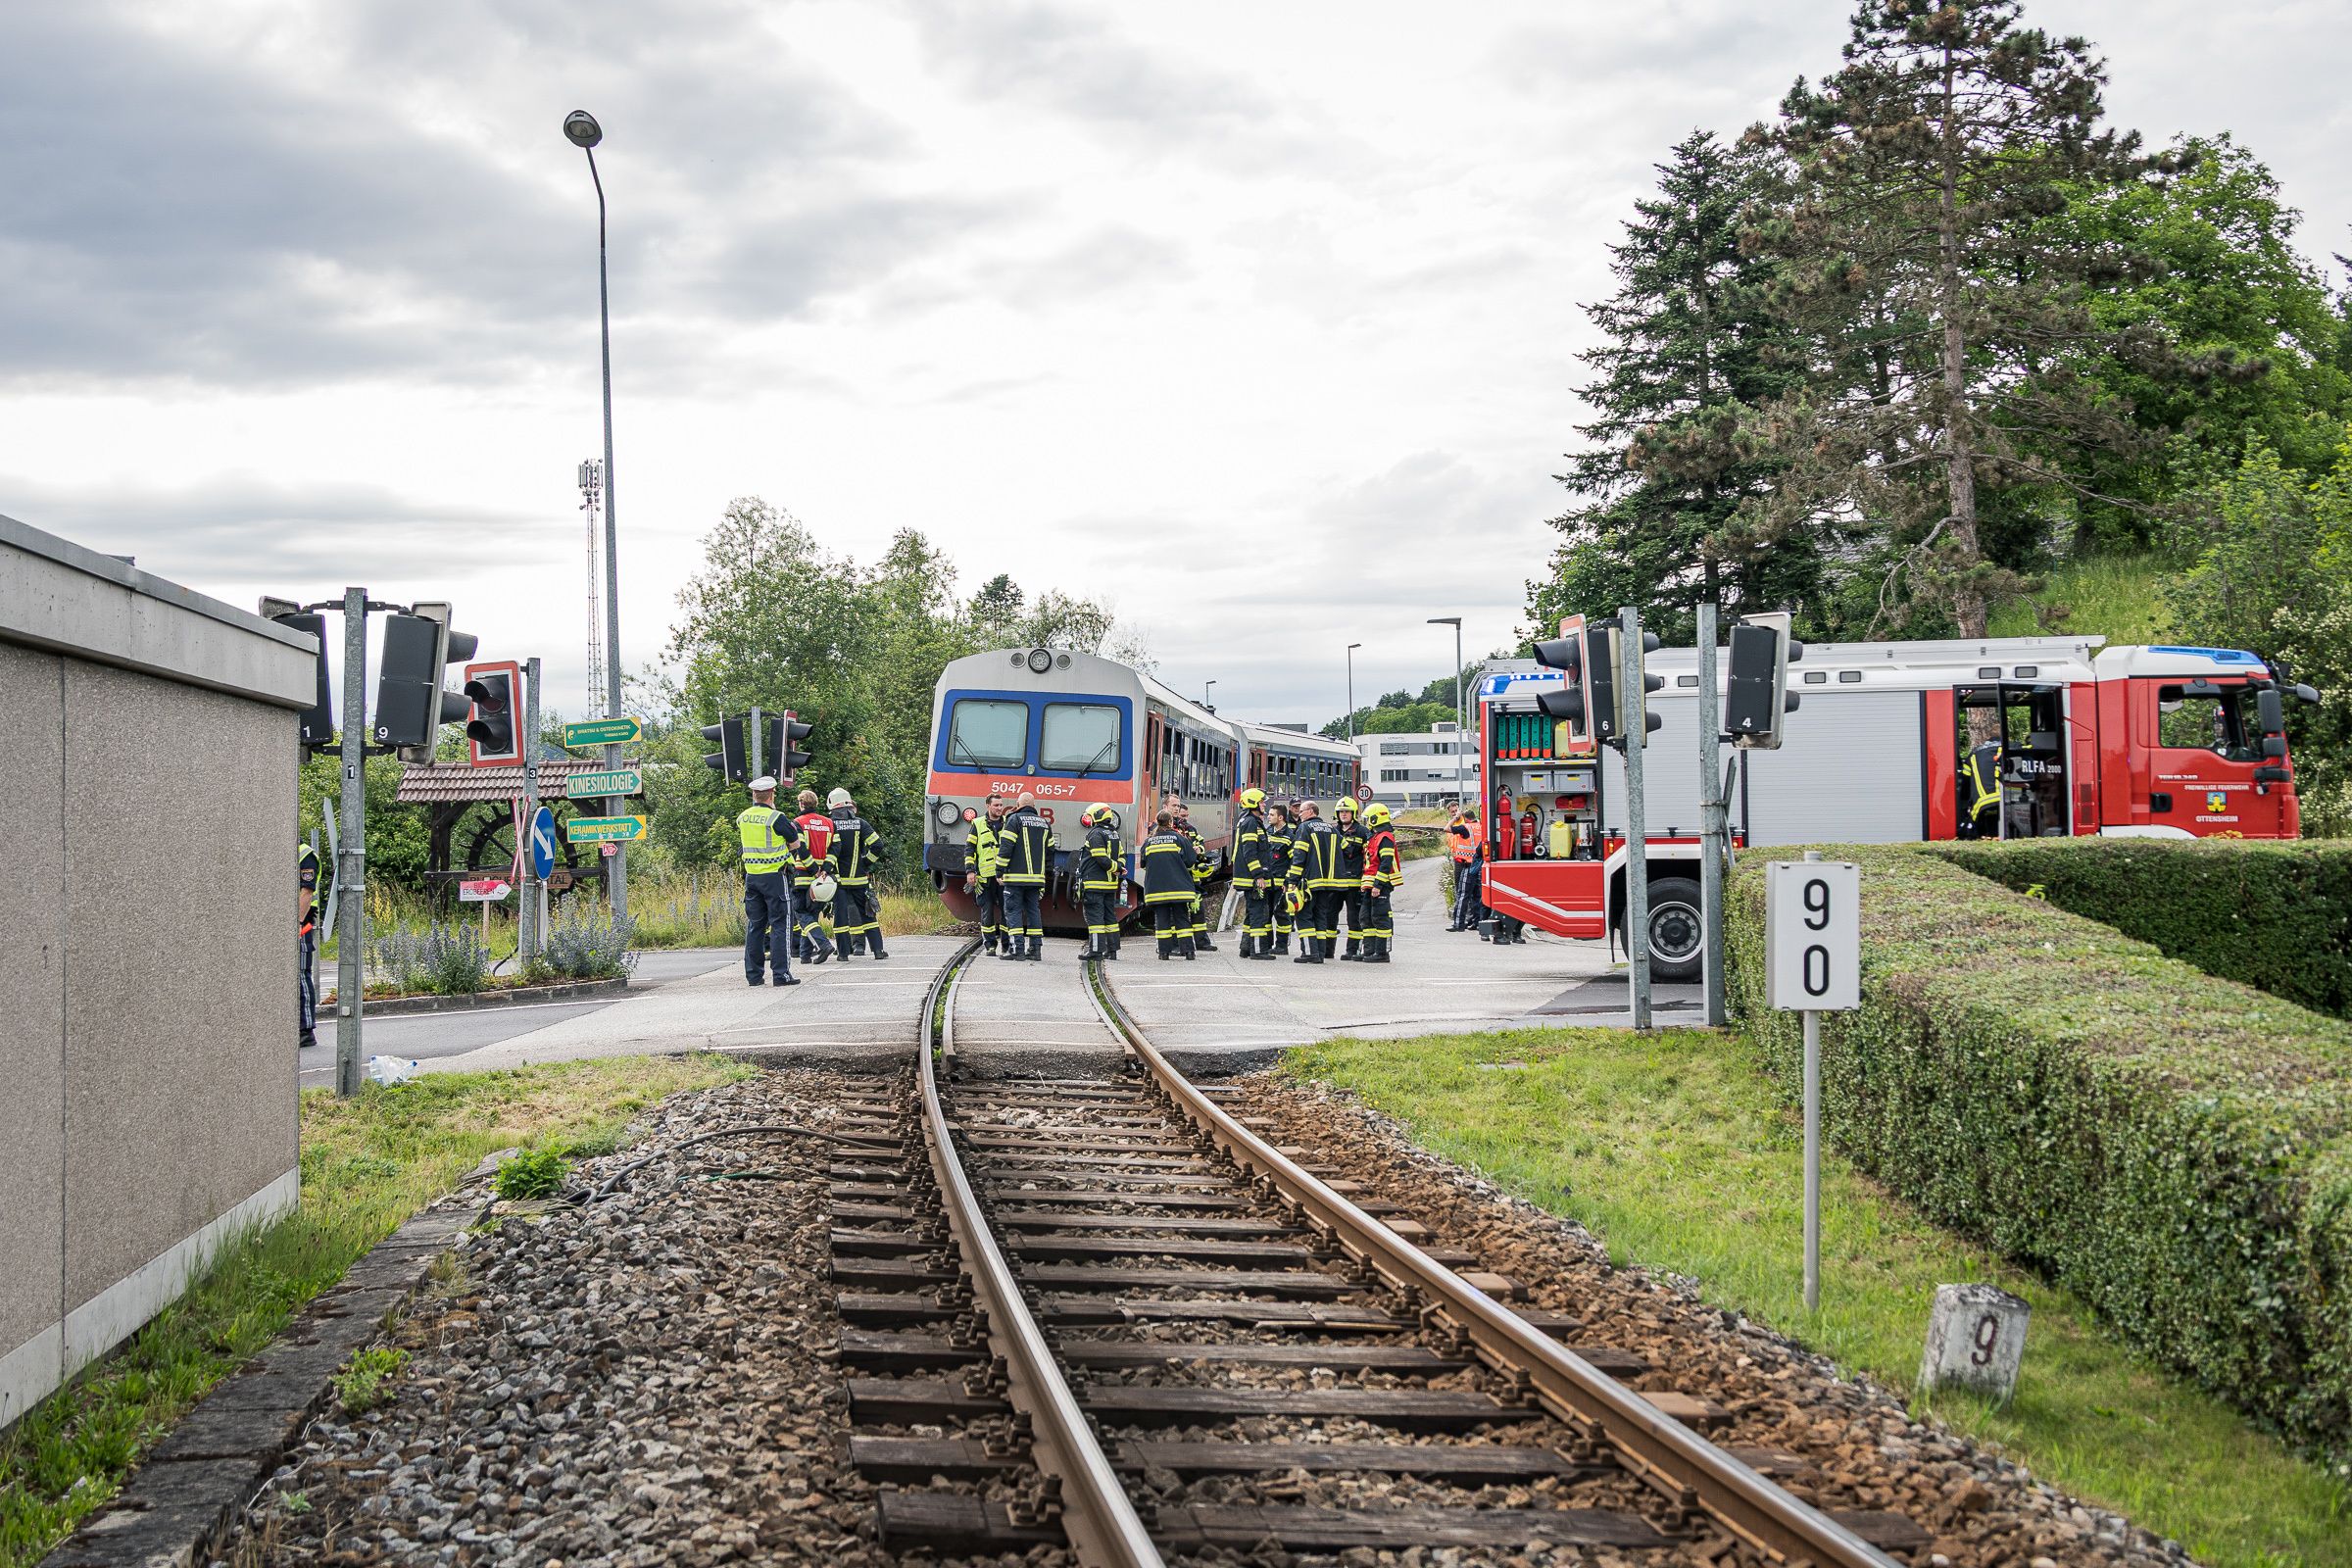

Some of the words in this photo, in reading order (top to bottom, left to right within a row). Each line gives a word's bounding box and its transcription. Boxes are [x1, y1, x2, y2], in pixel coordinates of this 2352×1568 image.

[1601, 720, 1609, 731] 6
[1741, 716, 1752, 728] 4
[303, 725, 311, 738] 1
[378, 726, 389, 739] 9
[347, 764, 355, 779] 1
[2021, 760, 2046, 773] RLFA
[529, 769, 537, 779] 3
[568, 773, 634, 795] KINESIOLOGIE
[991, 781, 1024, 794] 5047
[1036, 783, 1077, 797] 065-7
[1359, 788, 1369, 798] 30
[741, 813, 768, 825] OLIZEI
[569, 822, 632, 835] KERAMIKWERKSTATT
[1803, 878, 1830, 931] 9
[1803, 944, 1830, 997] 0
[1971, 1314, 1998, 1365] 9
